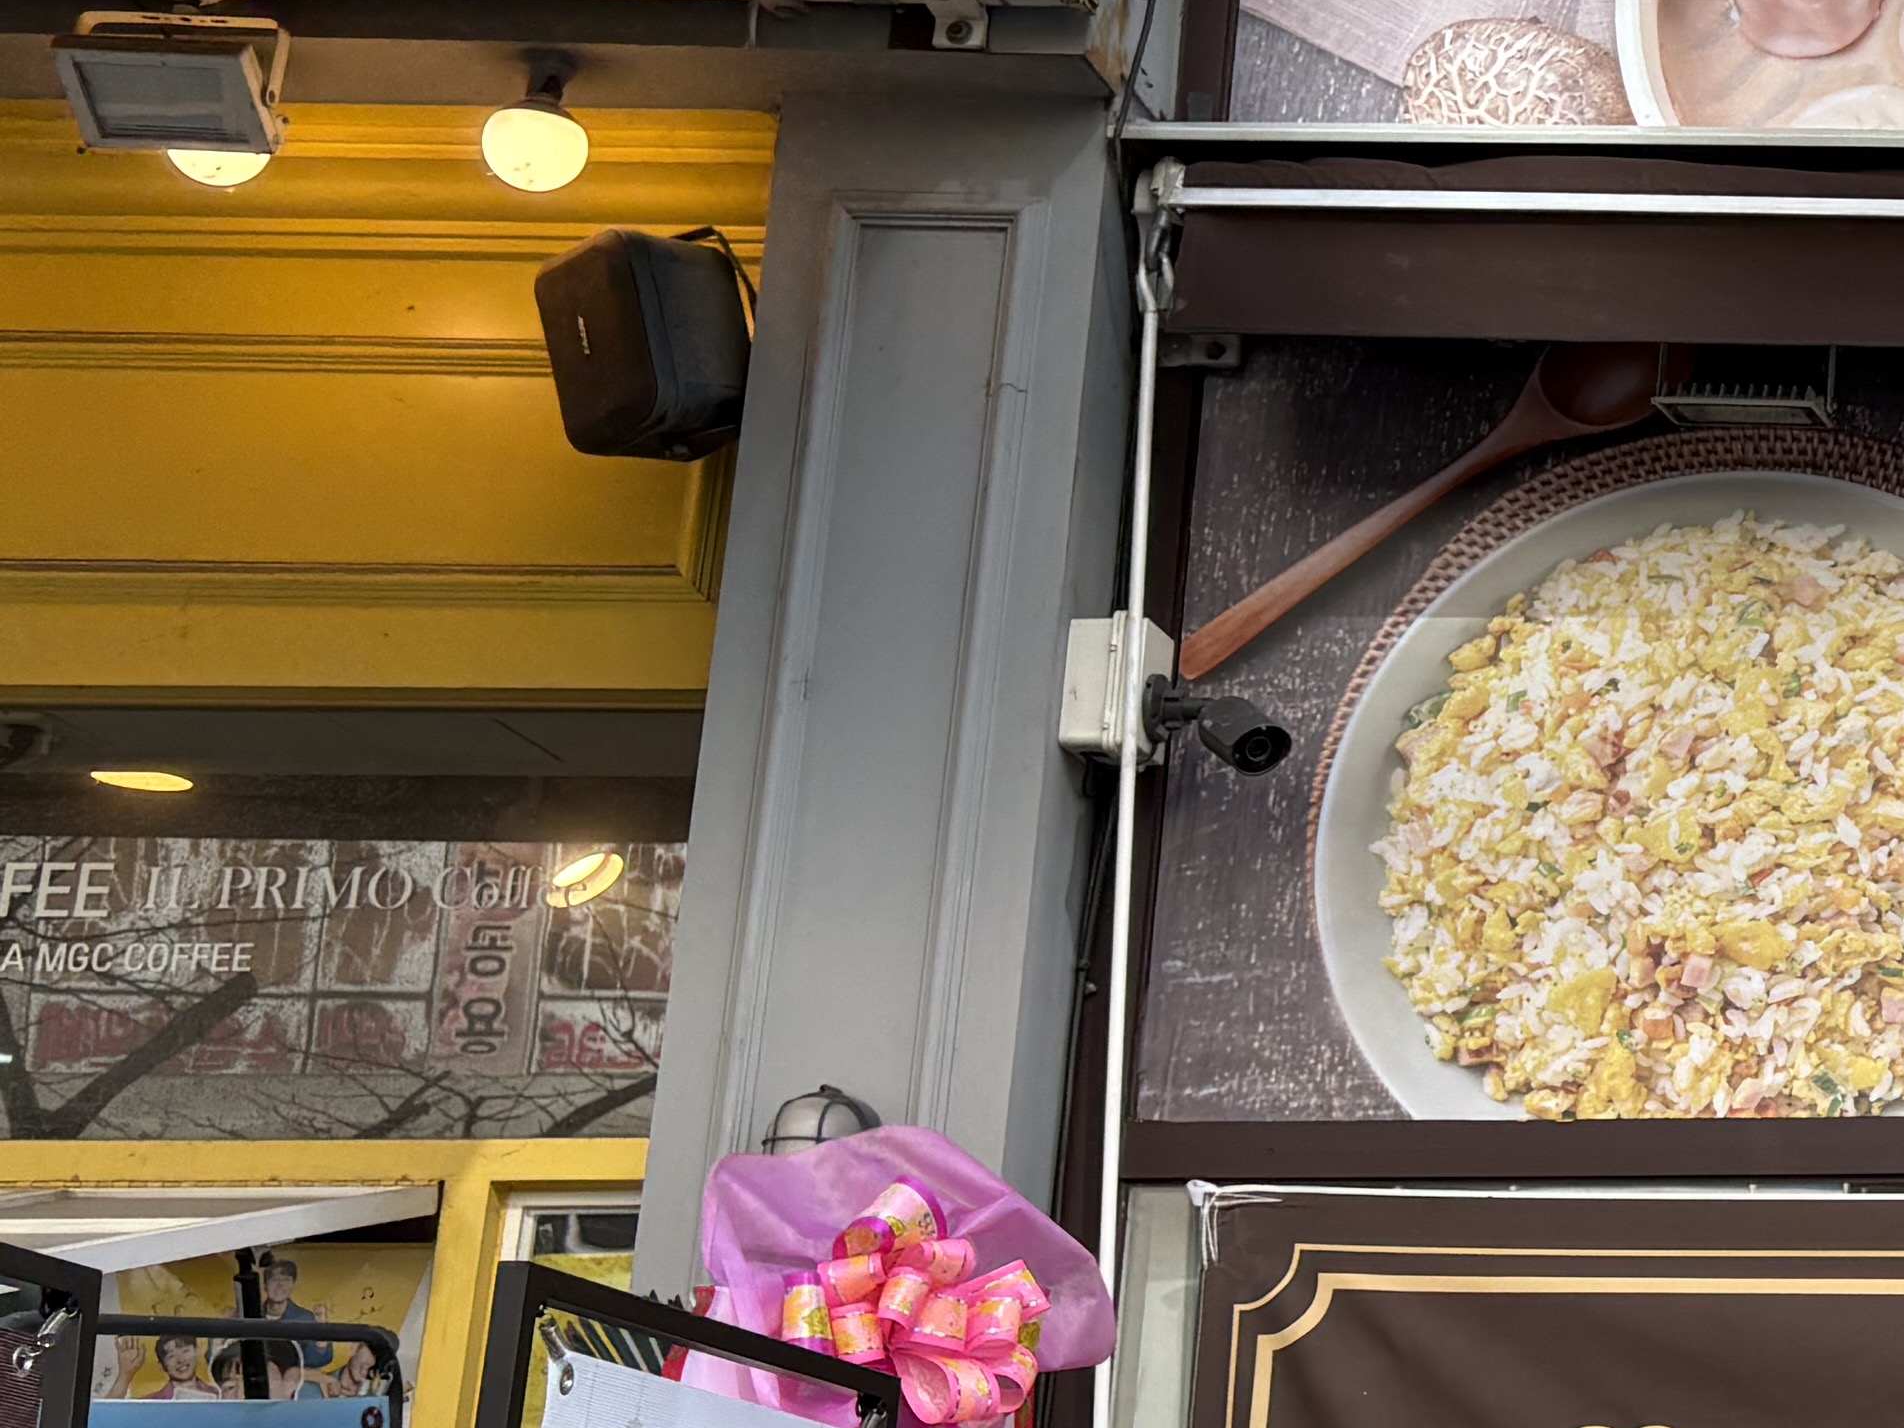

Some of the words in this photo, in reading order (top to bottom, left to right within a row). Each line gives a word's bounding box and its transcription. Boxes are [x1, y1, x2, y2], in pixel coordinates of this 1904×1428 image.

[216, 866, 414, 910] PRIMO
[36, 943, 113, 972] MGC
[124, 943, 254, 972] COFFEE
